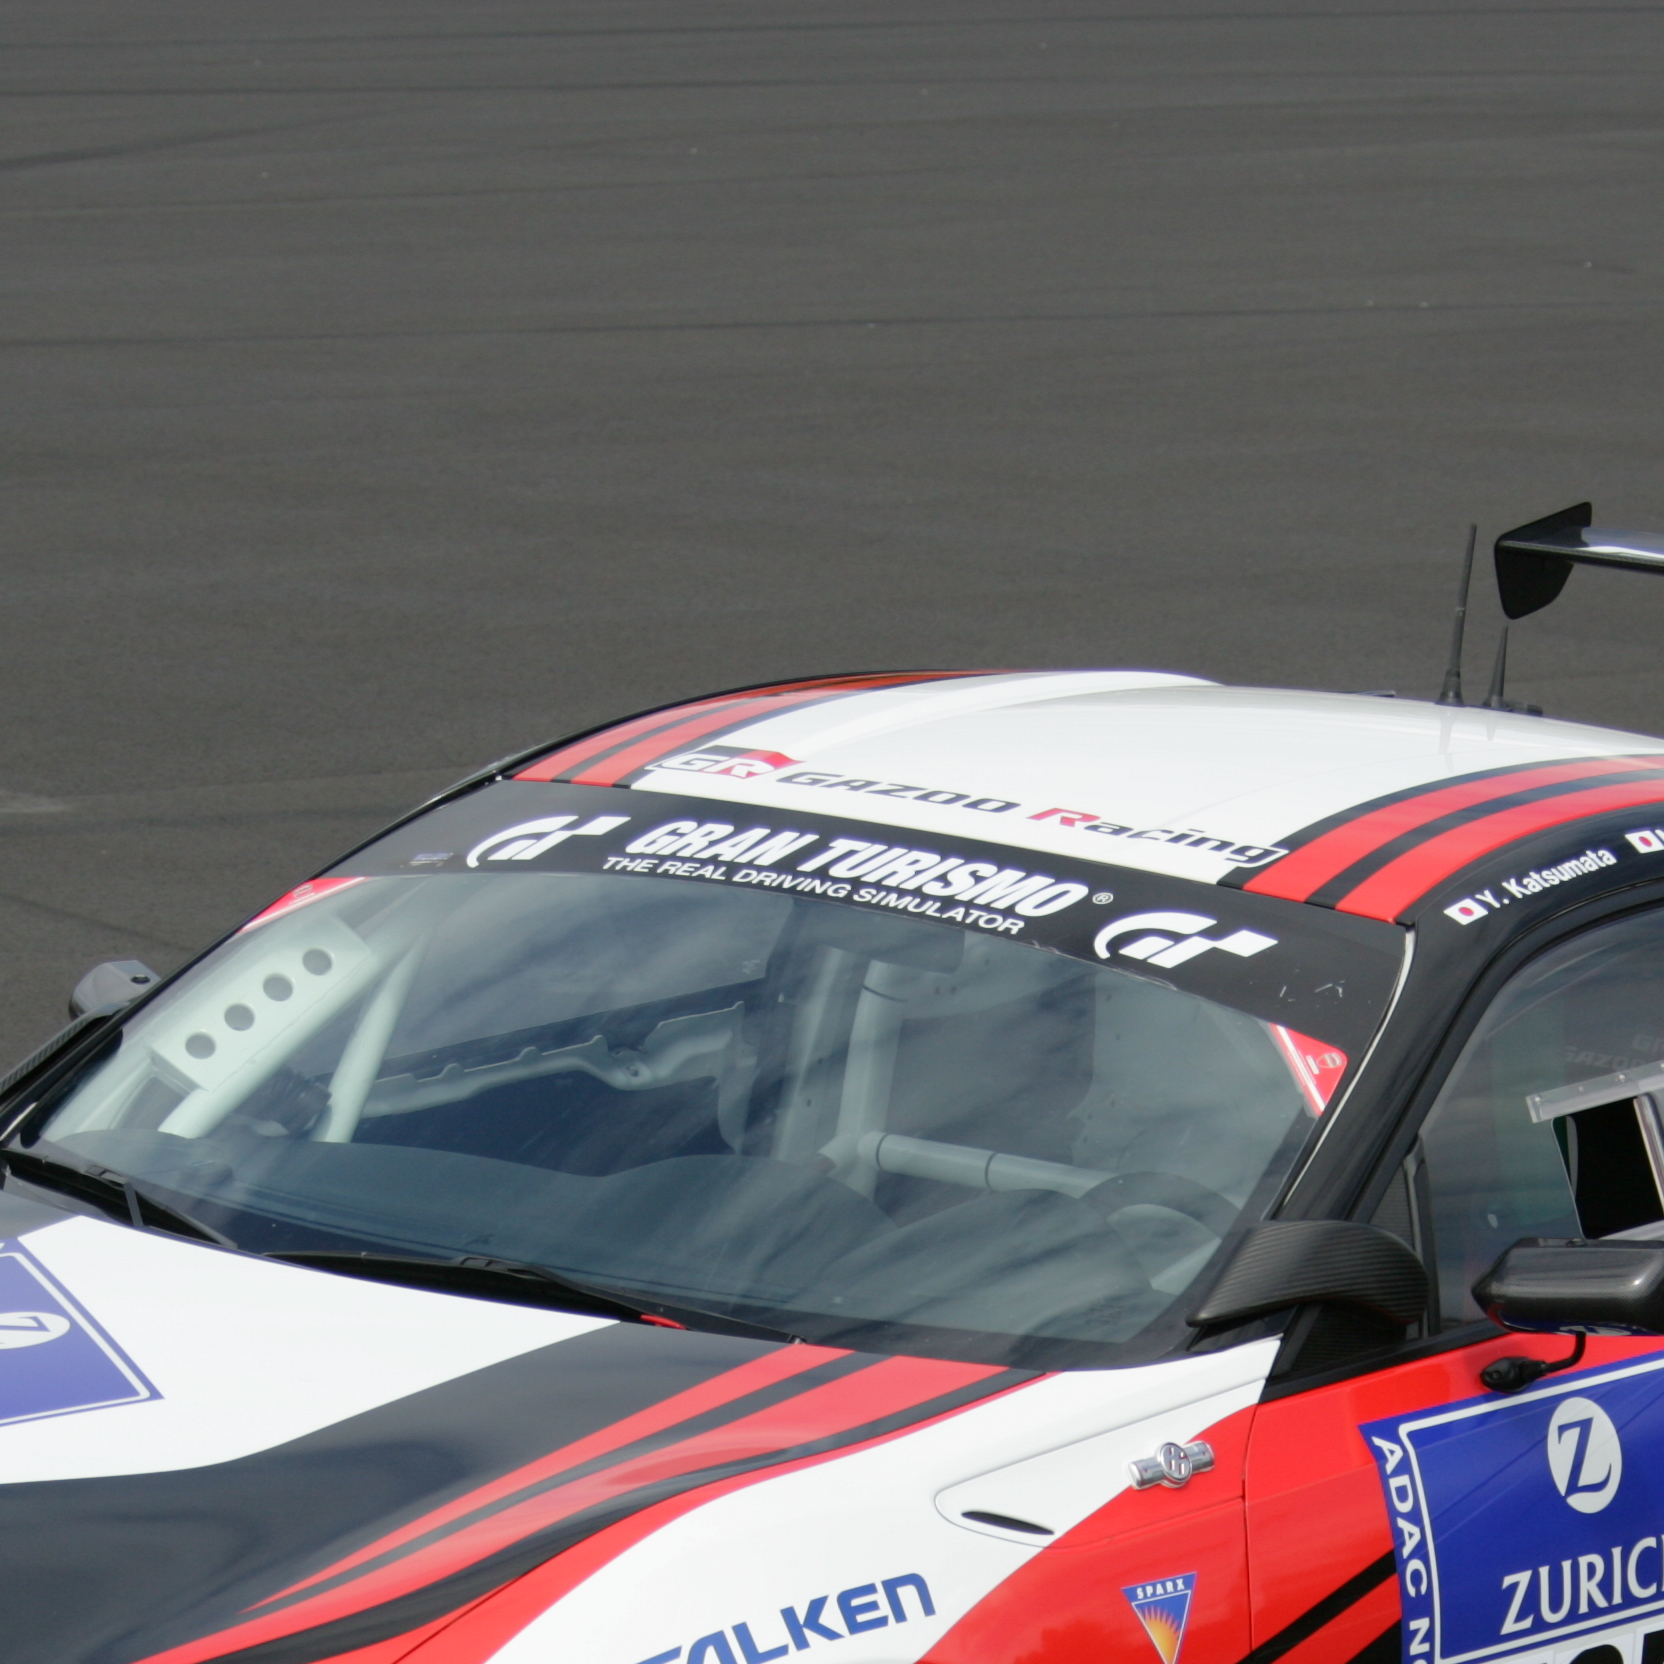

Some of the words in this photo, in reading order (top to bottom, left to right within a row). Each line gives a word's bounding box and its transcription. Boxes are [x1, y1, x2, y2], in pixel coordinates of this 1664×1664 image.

[776, 771, 1021, 813] GAZOO
[1026, 807, 1287, 867] Racing
[602, 857, 659, 874] THE
[656, 860, 728, 881] REAL
[731, 869, 852, 898] DRIVING
[852, 887, 1025, 935] SIMULATOR
[625, 820, 820, 868] GRAN
[797, 838, 1090, 917] TURISMO
[1476, 889, 1510, 909] Y.
[1502, 847, 1617, 898] Katsumata
[1370, 1435, 1428, 1598] ADAC
[1135, 1578, 1186, 1600] SPARX
